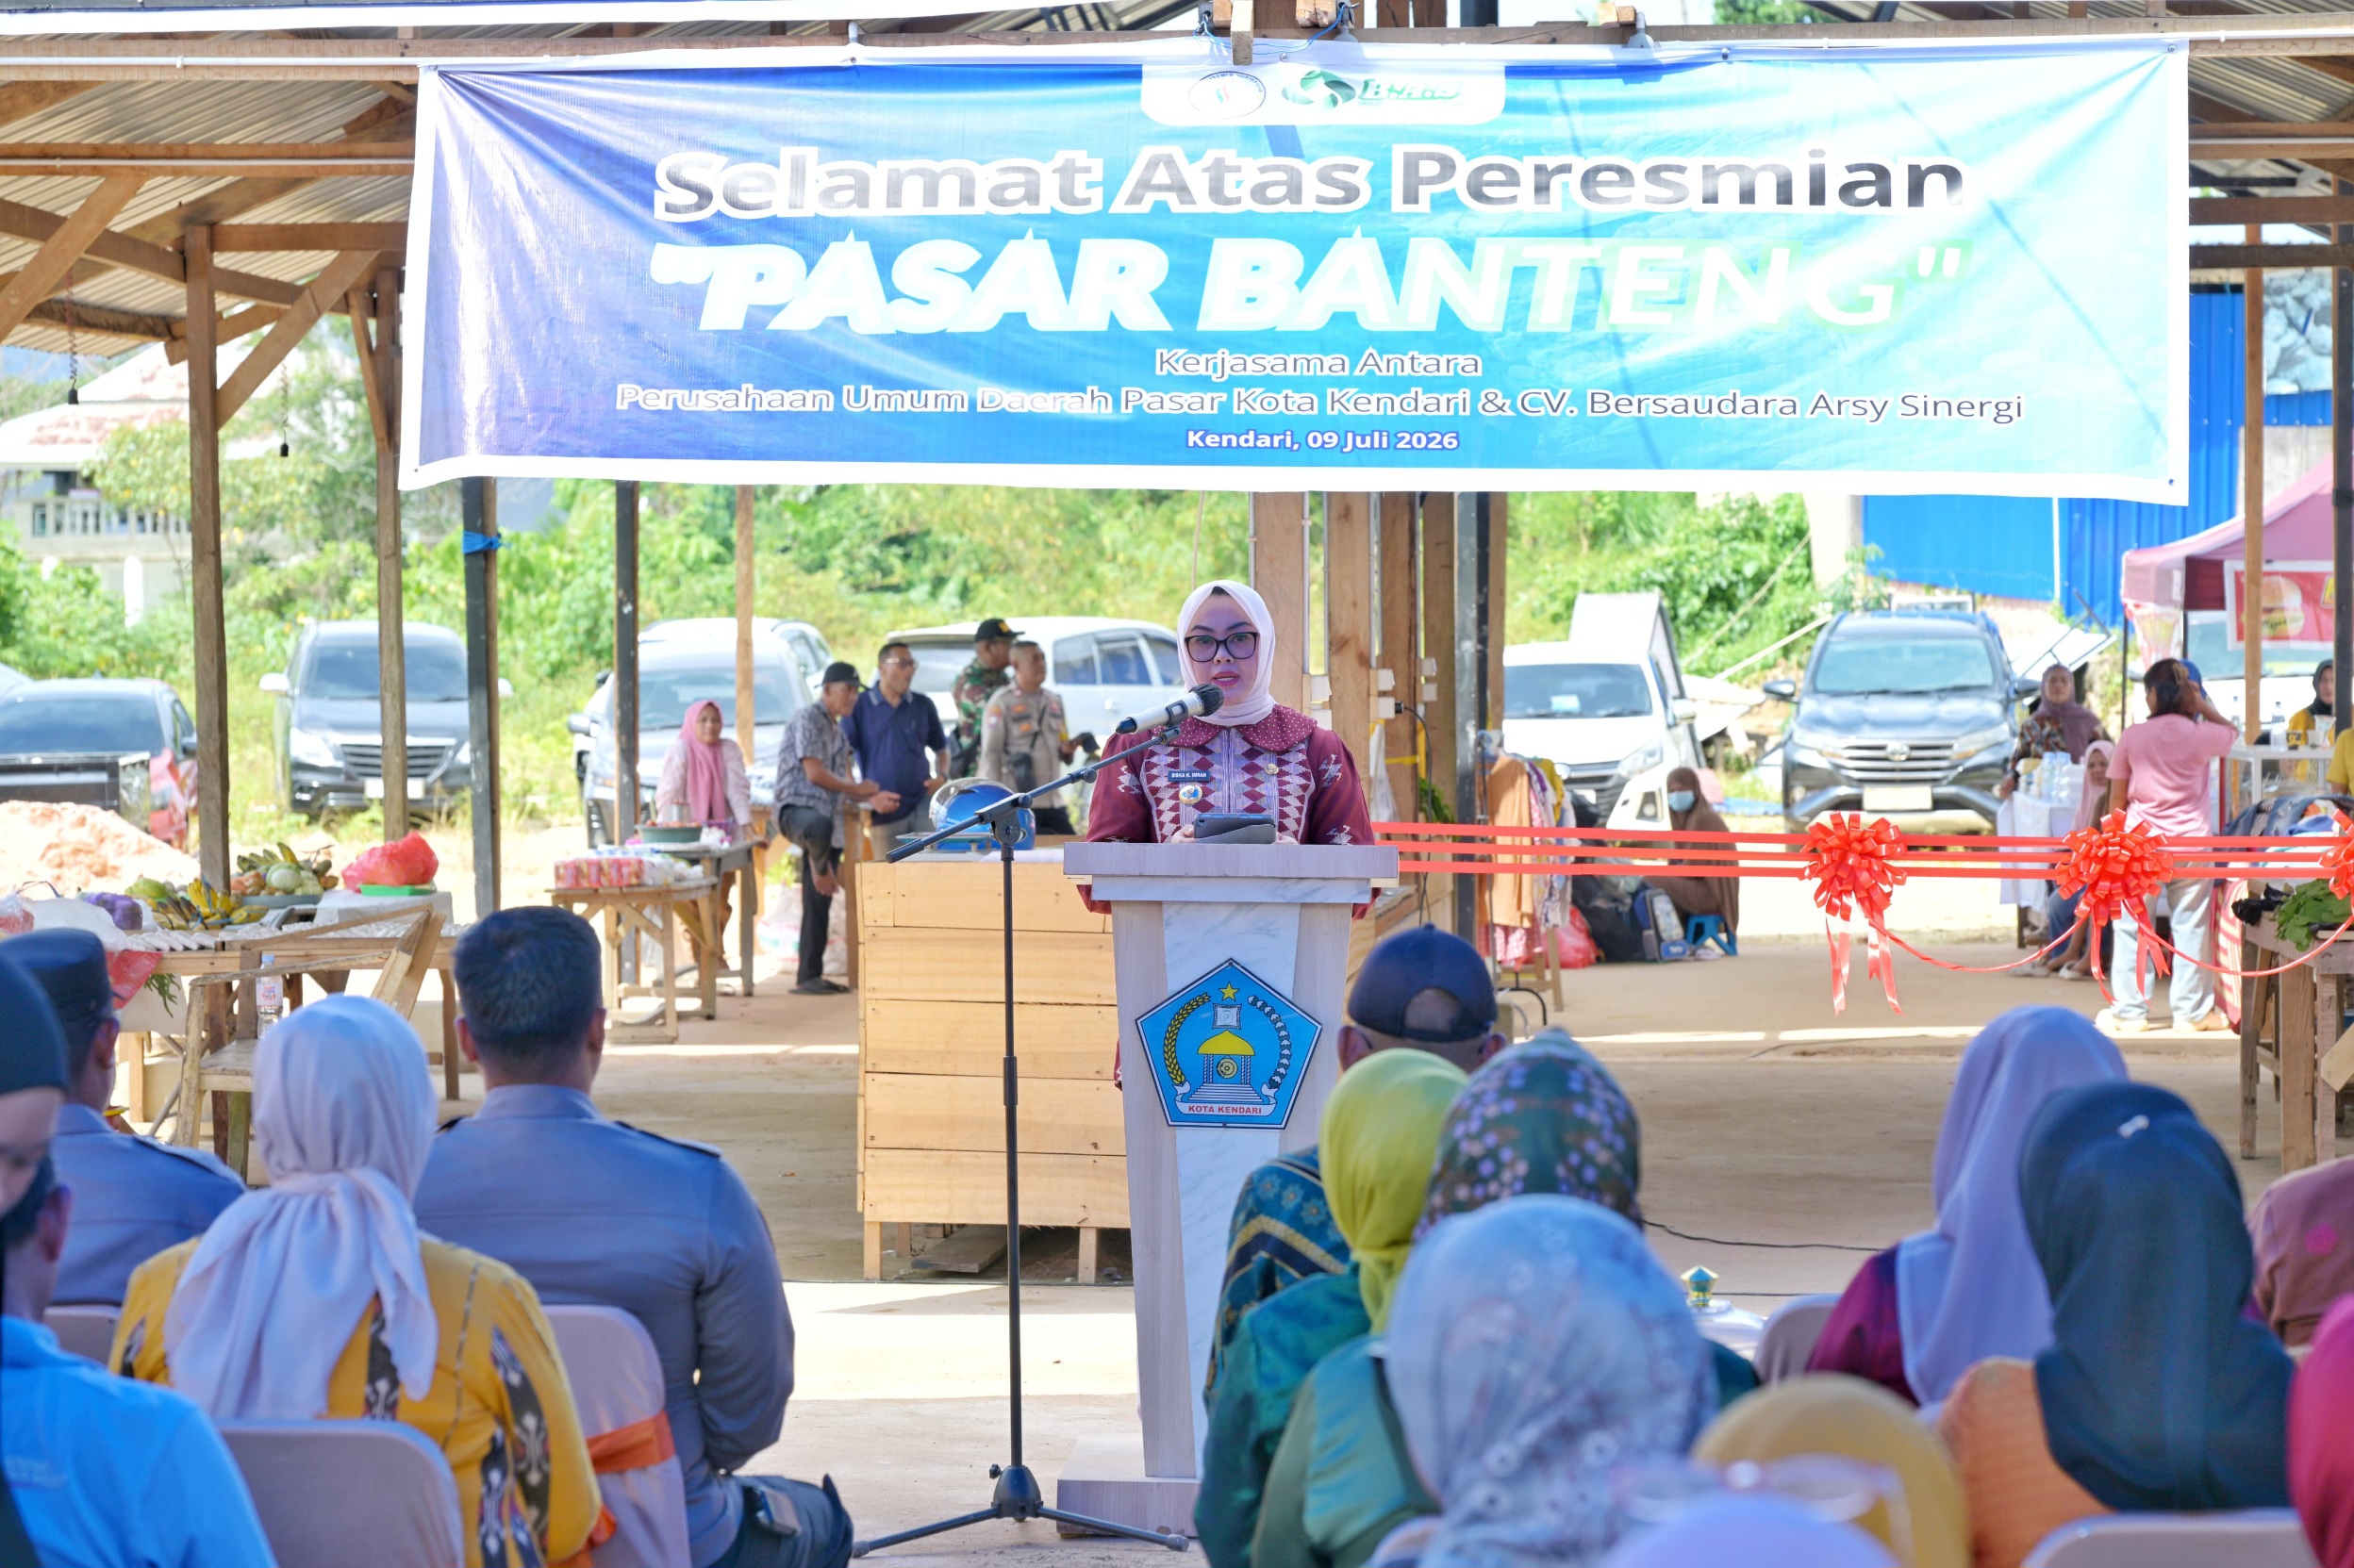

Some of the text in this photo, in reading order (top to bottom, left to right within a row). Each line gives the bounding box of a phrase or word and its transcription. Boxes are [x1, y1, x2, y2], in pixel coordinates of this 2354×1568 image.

[661, 147, 1967, 217] Selamat Atas Peresmian
[1157, 349, 1482, 380] Kerjasama Antara
[618, 385, 2023, 424] Perusahaan Umum Daerah Pasar Kota Kendari & CV. Bersaudara Arsy Sinergi
[1186, 430, 1459, 452] Kendari, 09 Juli 2026
[1188, 1105, 1262, 1114] KOTA KENDARI
